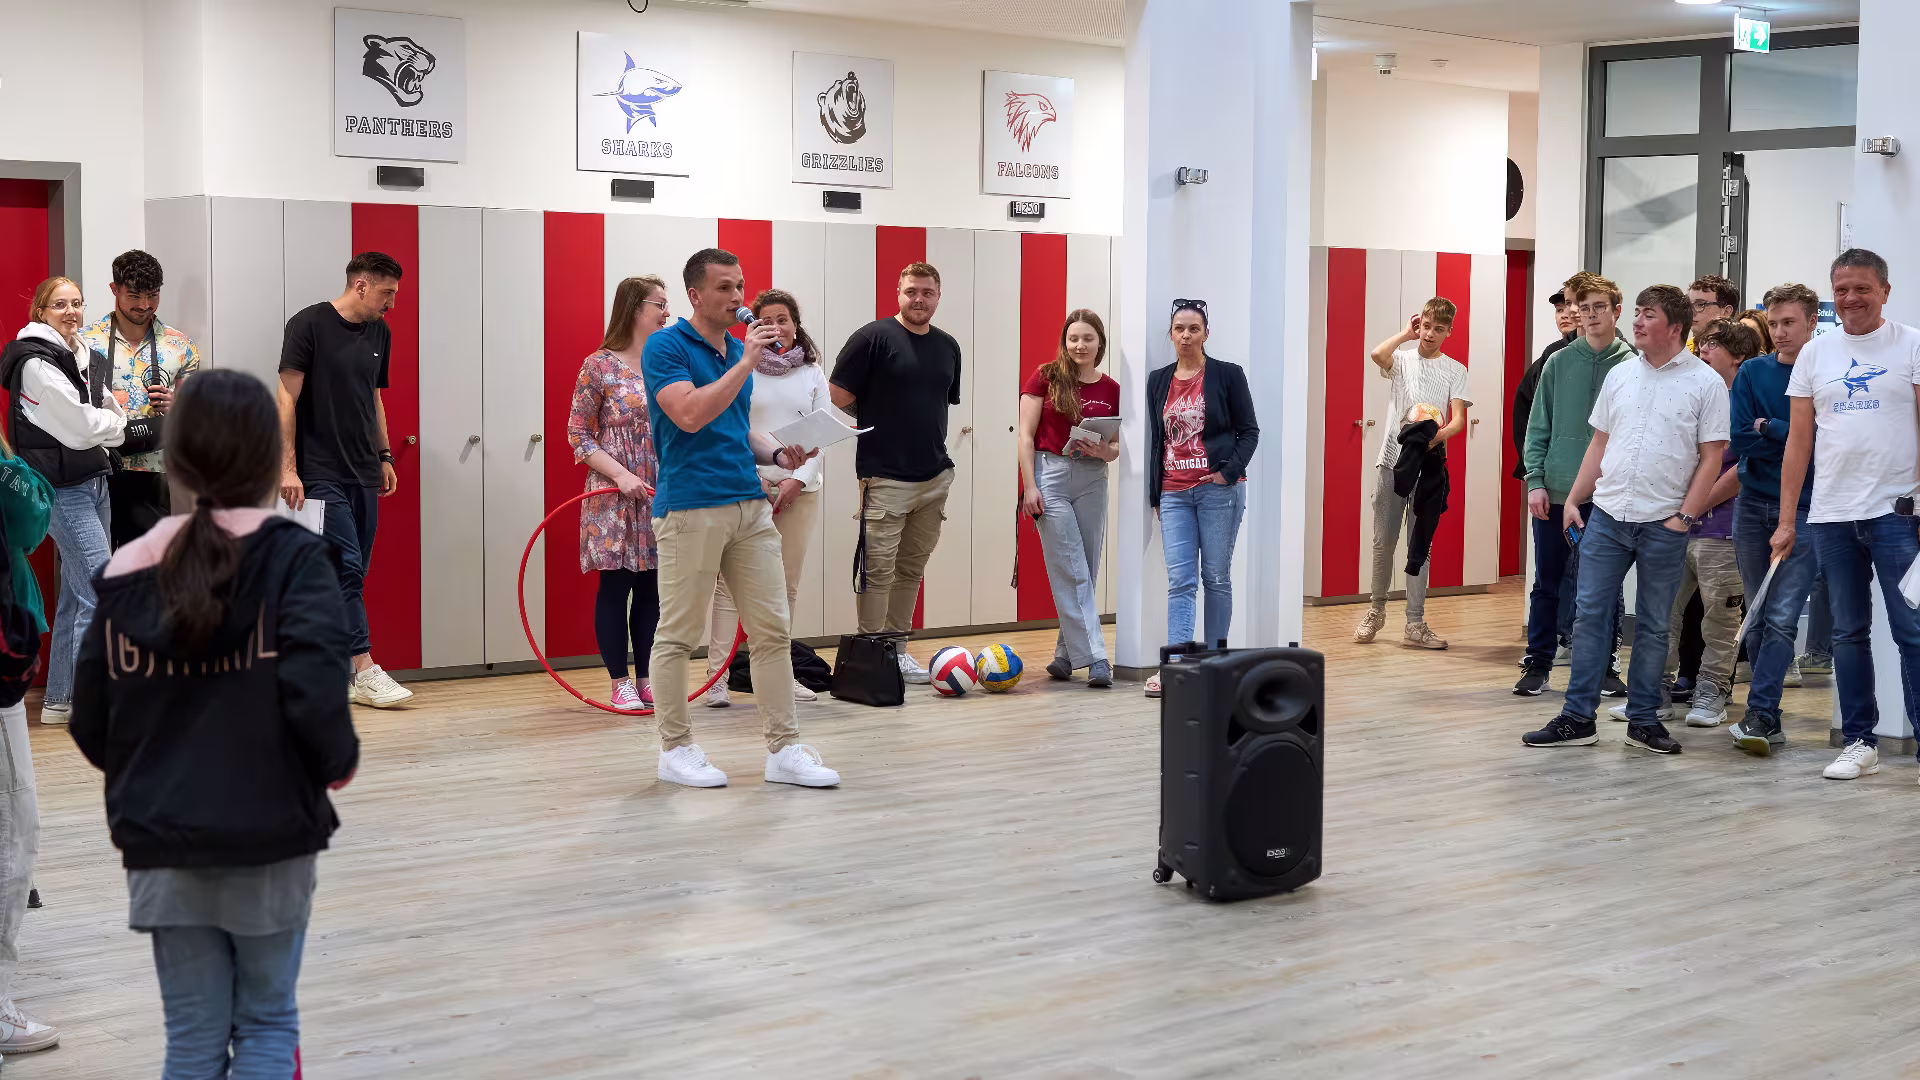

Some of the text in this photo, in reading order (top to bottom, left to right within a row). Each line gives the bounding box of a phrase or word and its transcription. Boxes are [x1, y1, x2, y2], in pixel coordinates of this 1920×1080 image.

[345, 115, 453, 138] PANTHERS
[601, 138, 673, 159] SHARKS
[801, 152, 884, 172] GRIZZLIES
[997, 161, 1060, 179] FALCONS
[1832, 399, 1880, 413] SHARKS
